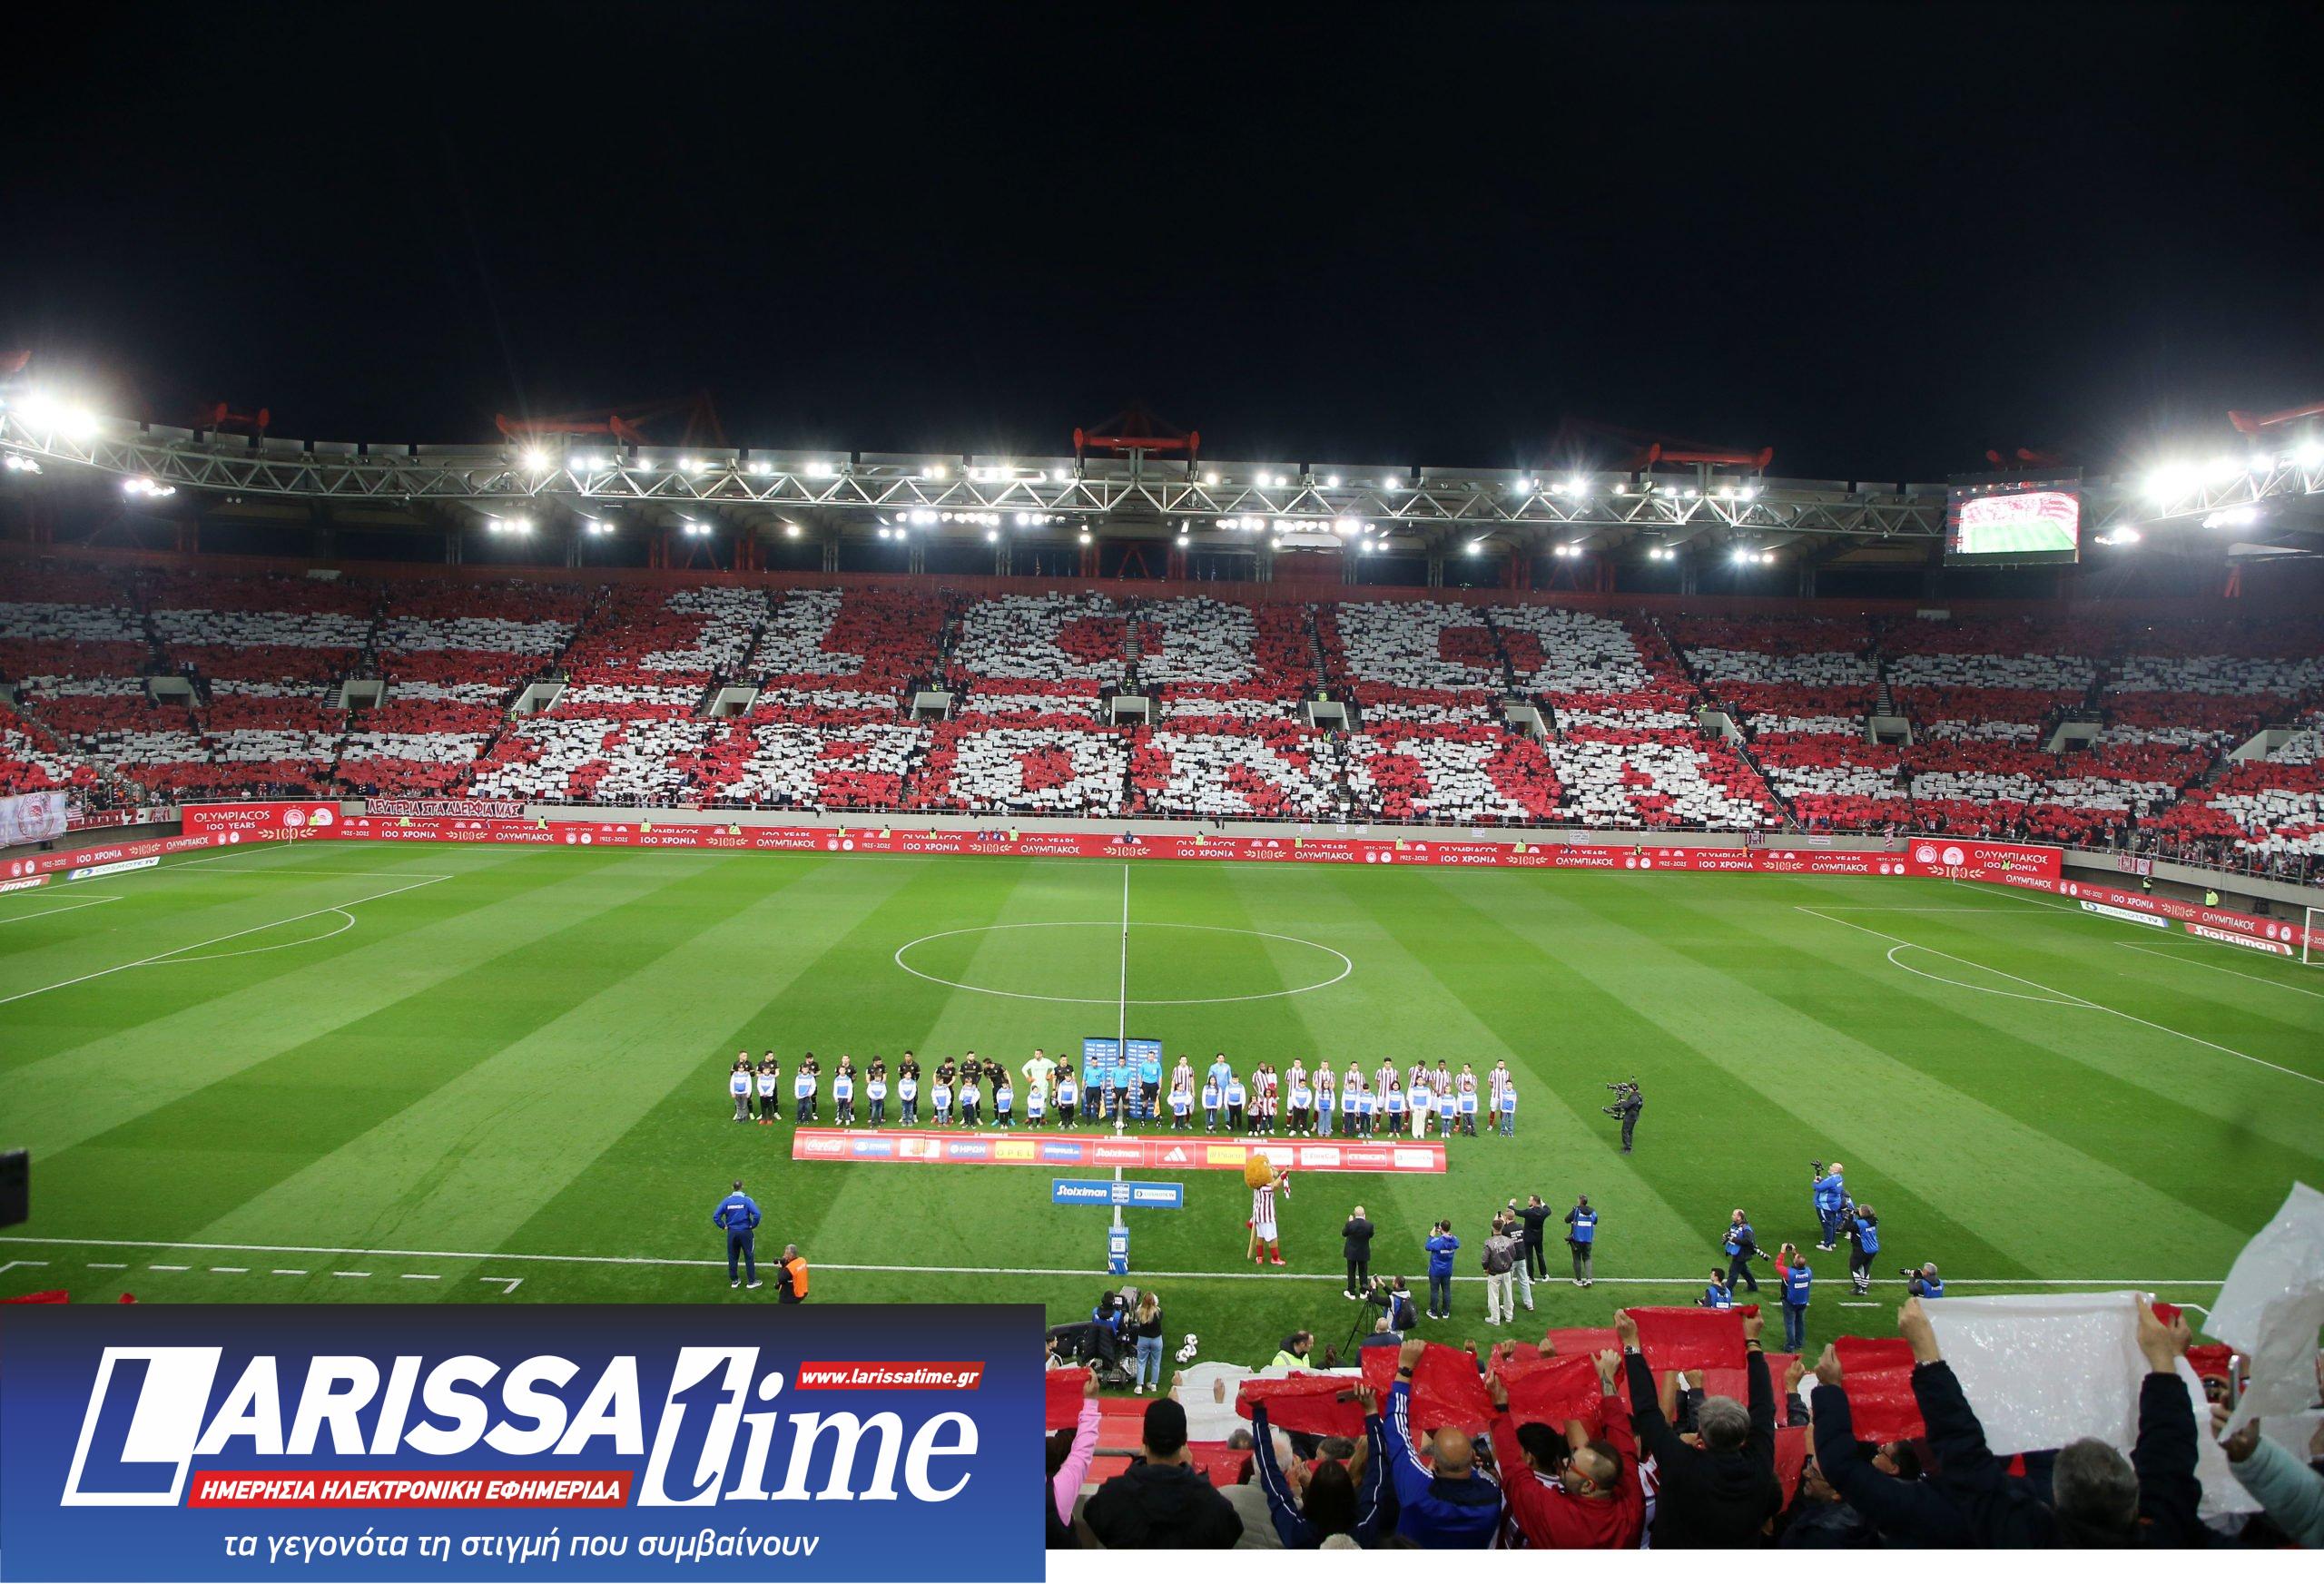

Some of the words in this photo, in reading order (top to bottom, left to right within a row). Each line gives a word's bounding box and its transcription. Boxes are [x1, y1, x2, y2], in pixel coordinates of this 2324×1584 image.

[495, 802, 521, 819] ΜΑΣ
[193, 811, 271, 823] OLYMPIACOS
[228, 822, 256, 830] YEARS
[402, 831, 437, 839] ΧΡΟΝΙΑ
[496, 832, 555, 842] ΟΛΥΜΠΙΑΚΟΣ
[640, 836, 658, 844] 100
[662, 837, 697, 845] ΧΡΟΝΙΑ
[756, 839, 816, 849] ΟΛΥΜΠΙΑΚΟΣ
[924, 843, 960, 851] ΧΡΟΝΙΑ
[1020, 845, 1080, 855] ΟΛΥΜΠΙΑΚΟΣ
[75, 854, 92, 864] 100
[94, 850, 123, 862] ΧΡΟΝΙΑ
[1199, 850, 1235, 858] ΧΡΟΝΙΑ
[1295, 851, 1354, 861] ΟΛΥΜΠΙΑΚΟΣ
[1974, 850, 2049, 865] ΟΛΥΜΠΙΑΚΟΣ
[1441, 855, 1458, 863] 100
[1462, 856, 1497, 864] ΧΡΟΝΙΑ
[1555, 858, 1614, 868] ΟΛΥΜΠΙΑΚΟΣ
[1699, 861, 1717, 869] 100
[1719, 861, 1754, 870] ΧΡΟΝΙΑ
[1811, 862, 1868, 873] ΟΛΥΜΠΙΑΚΟΣ
[2008, 862, 2039, 872] ΡΟΝΙΑ
[2111, 894, 2125, 904] 100
[2126, 898, 2154, 910] ΧΡΟΝΙΑ
[2202, 912, 2256, 932] ΟΛΥΜΠΙΑΚΟΣ
[2194, 926, 2278, 953] Stoiximan
[997, 1148, 1032, 1156] OPEL
[1057, 1185, 1107, 1198] Stoiximan
